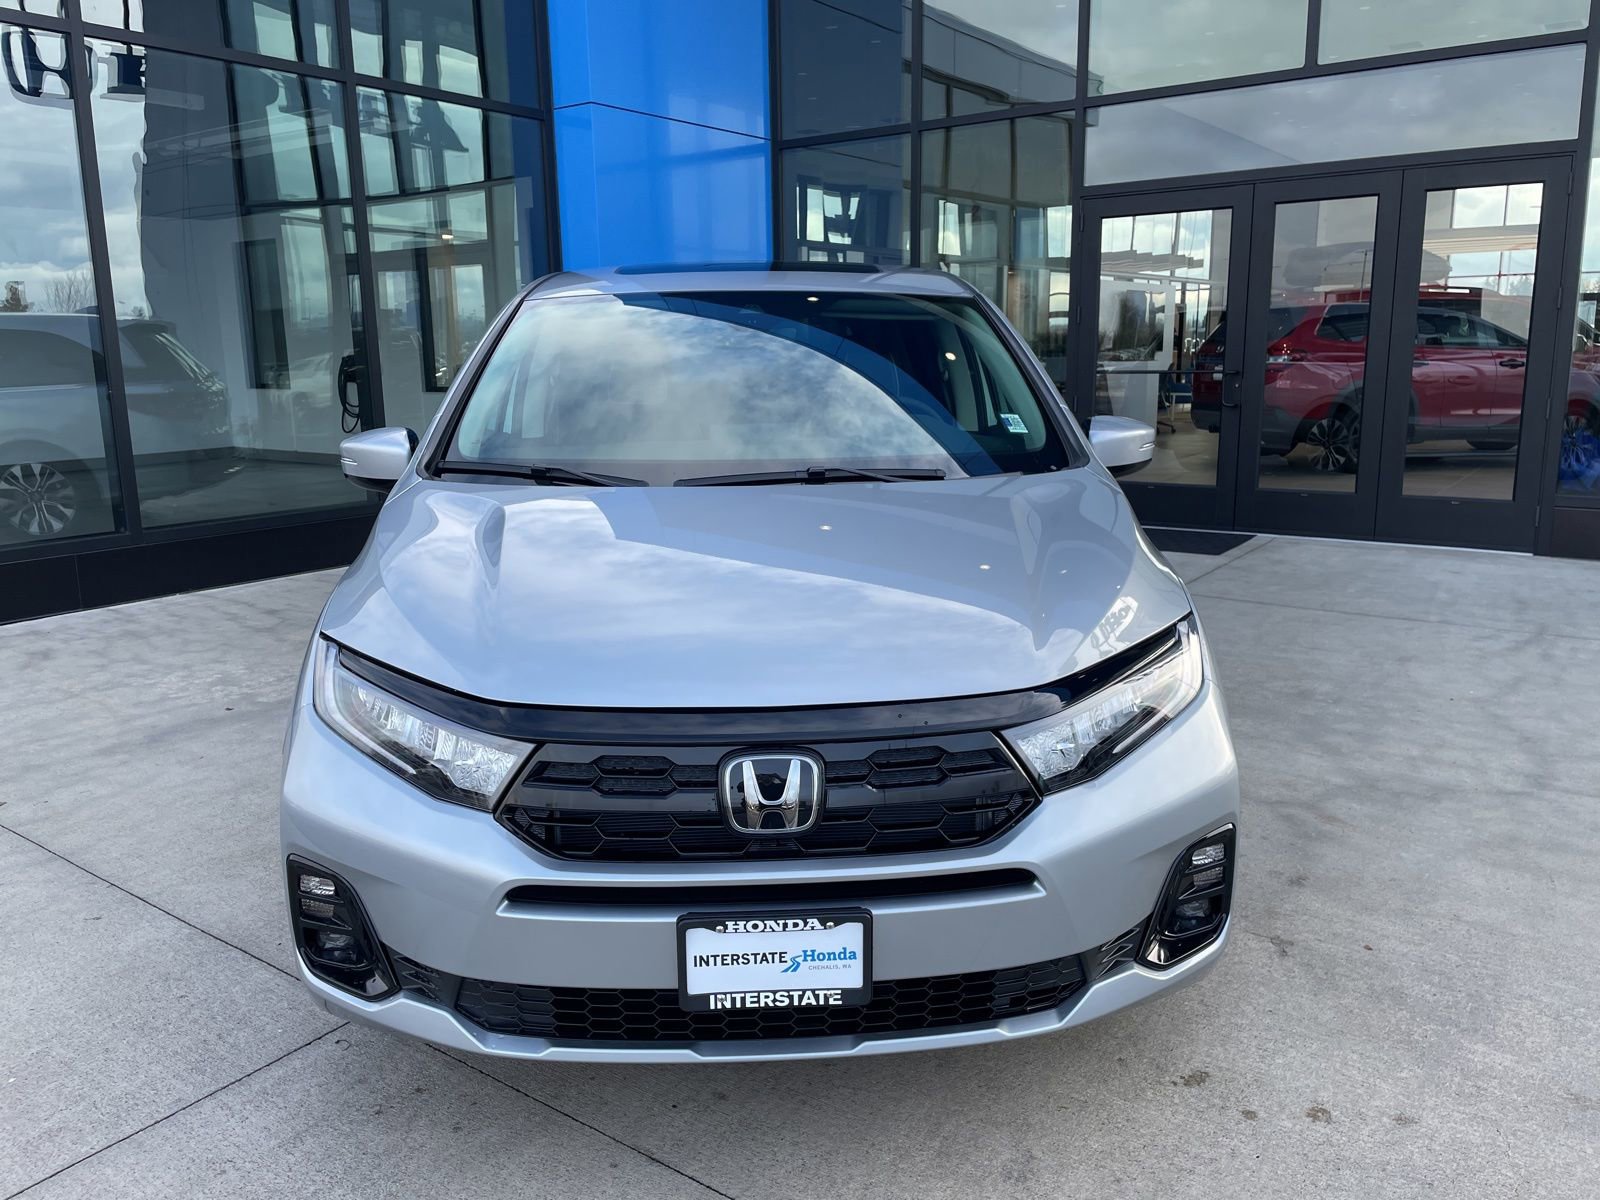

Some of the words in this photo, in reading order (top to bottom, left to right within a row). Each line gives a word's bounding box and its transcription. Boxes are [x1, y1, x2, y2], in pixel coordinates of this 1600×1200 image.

[725, 918, 824, 934] HONDA
[693, 951, 788, 968] INTERSTATE
[801, 947, 857, 962] Honda
[709, 989, 843, 1010] INTERSTATE
